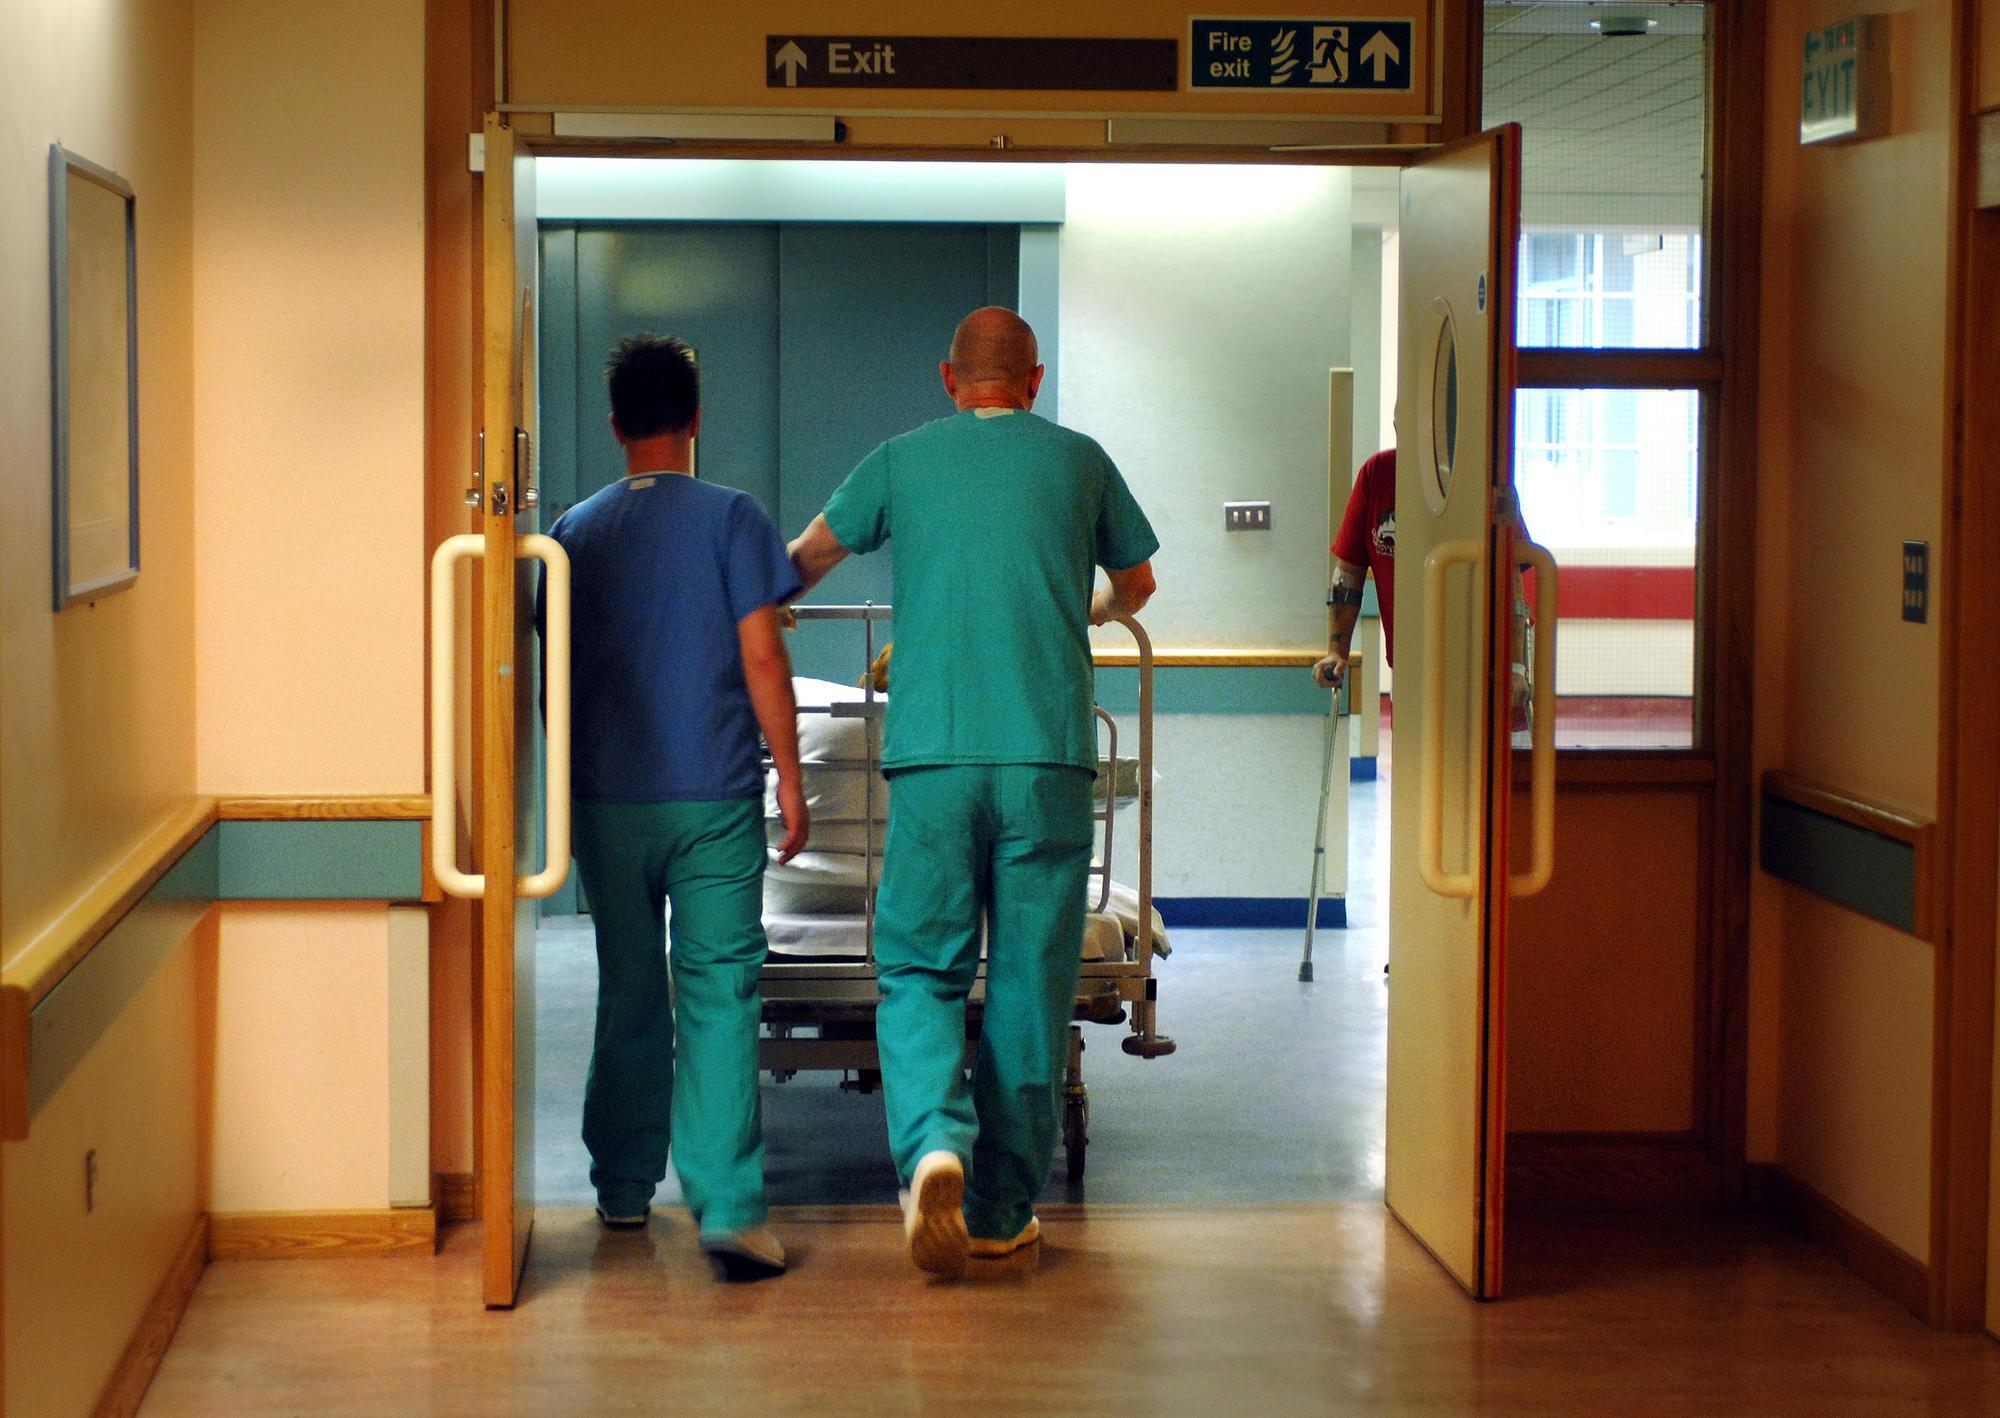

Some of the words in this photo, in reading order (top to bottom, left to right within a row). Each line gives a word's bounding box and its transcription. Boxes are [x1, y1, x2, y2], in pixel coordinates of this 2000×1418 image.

[1209, 31, 1252, 51] Fire
[828, 43, 895, 74] Exit
[1209, 58, 1250, 77] exit
